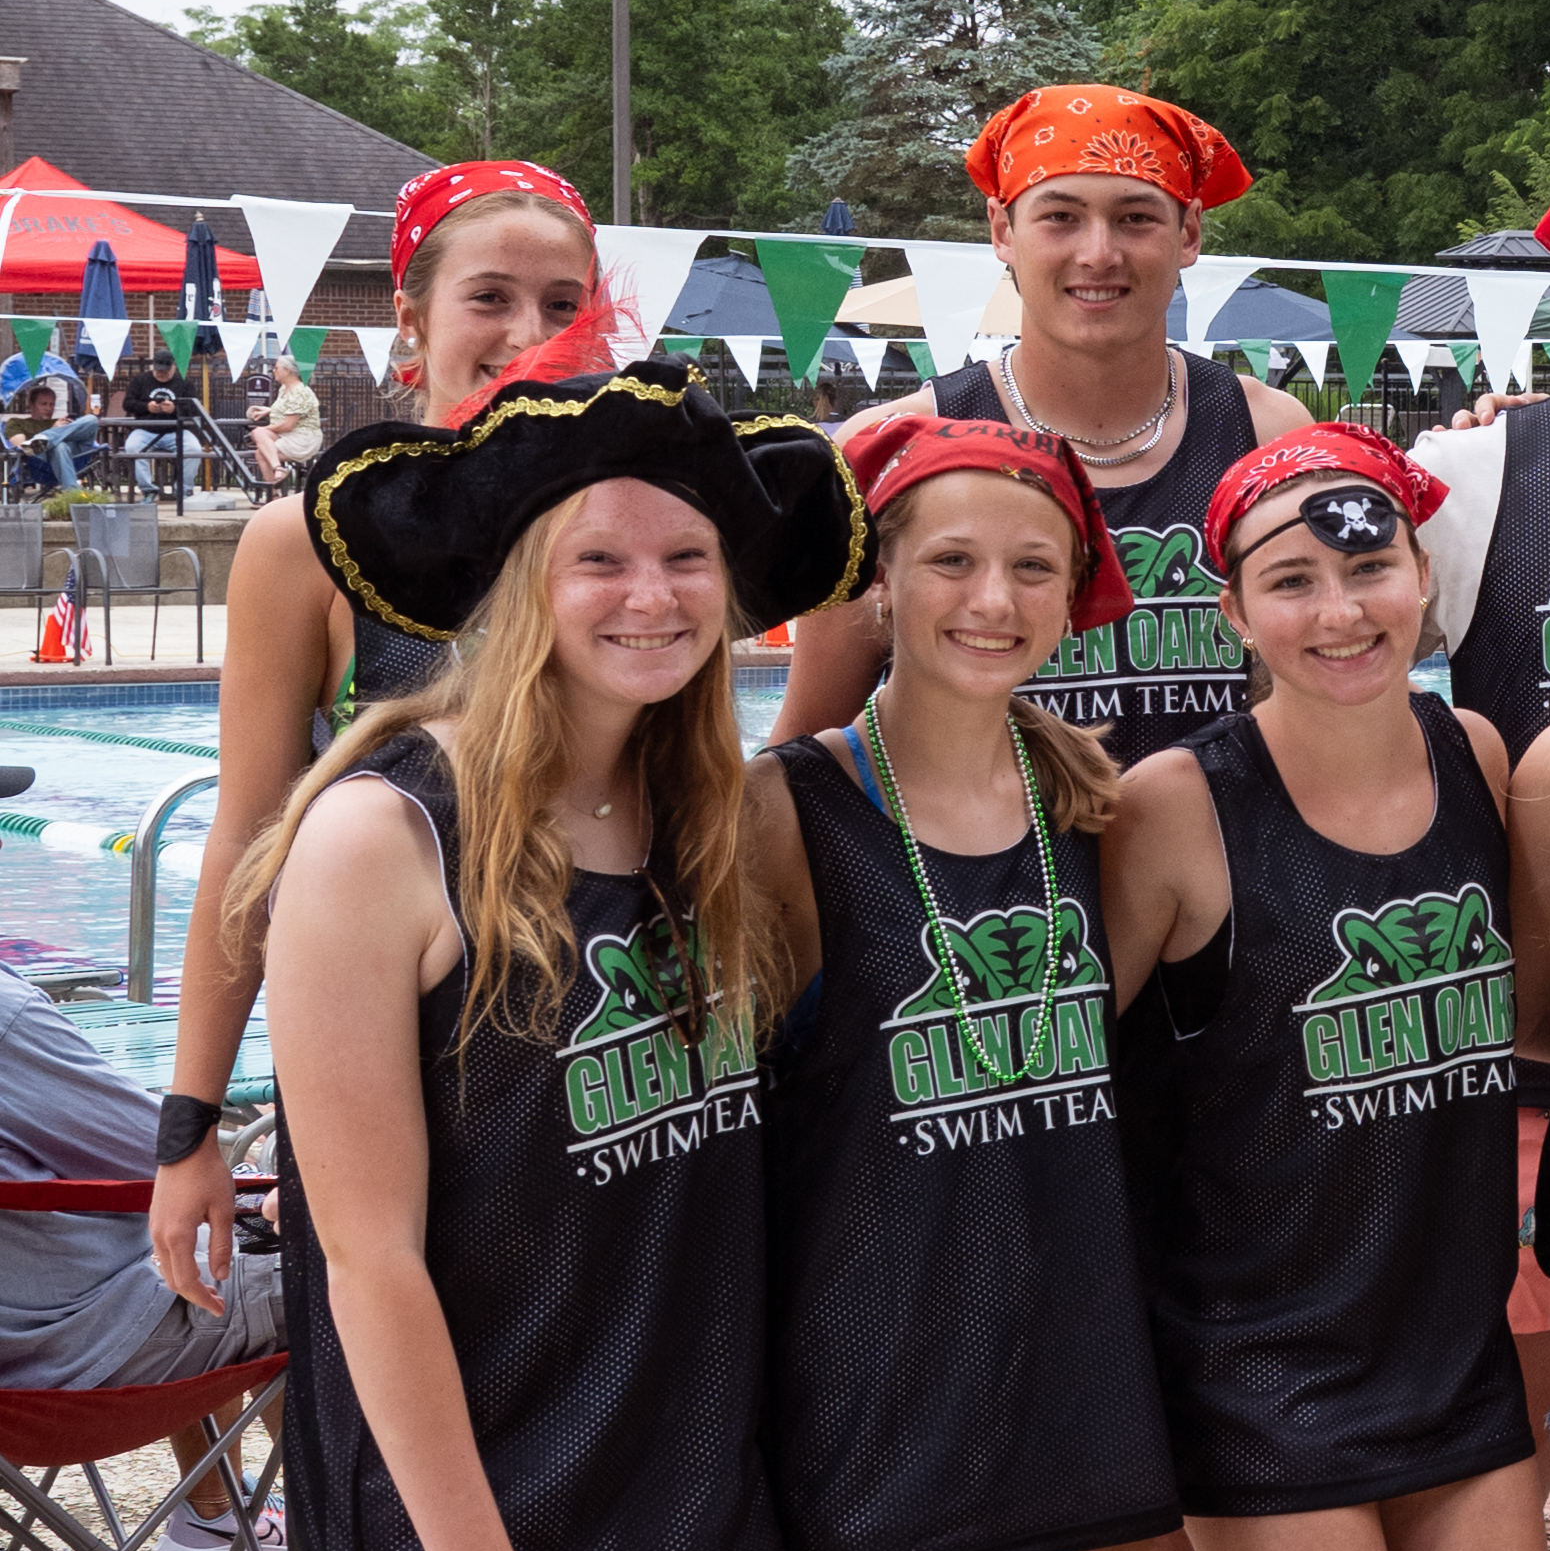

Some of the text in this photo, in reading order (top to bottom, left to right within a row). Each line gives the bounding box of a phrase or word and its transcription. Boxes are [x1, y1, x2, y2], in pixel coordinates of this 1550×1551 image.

[1127, 608, 1244, 671] OAKS
[1024, 683, 1236, 721] WIM TEAM
[889, 996, 1109, 1106] GLEN OAK
[1303, 995, 1429, 1082] GLEN
[566, 1025, 692, 1135] GLEN
[1326, 1078, 1438, 1130] SWIM
[593, 1092, 762, 1186] SWIM TEA
[914, 1087, 1113, 1155] SWIM TEA
